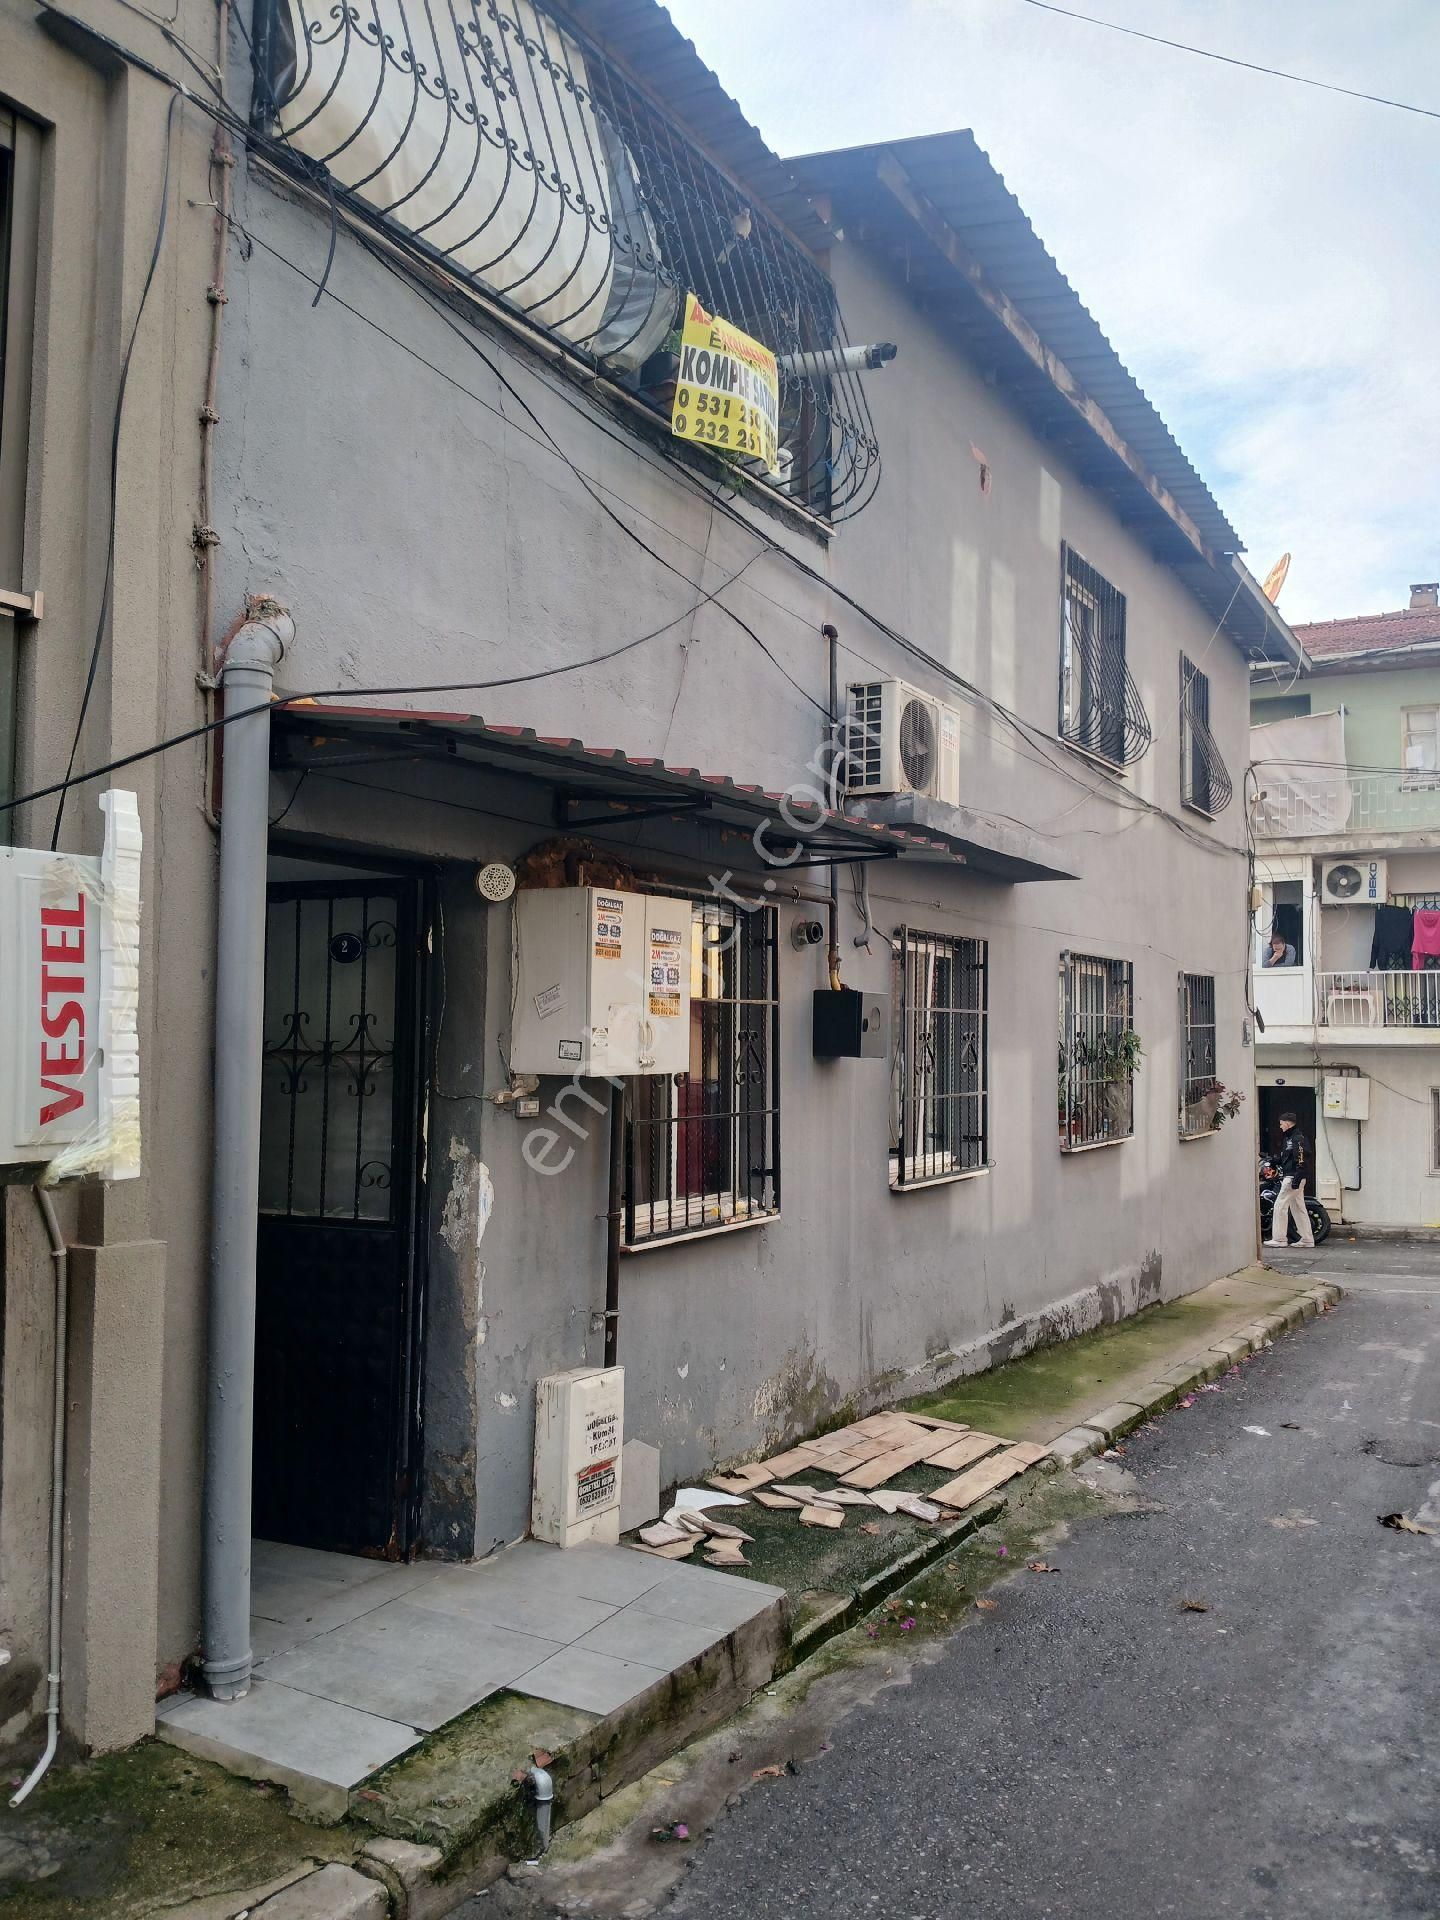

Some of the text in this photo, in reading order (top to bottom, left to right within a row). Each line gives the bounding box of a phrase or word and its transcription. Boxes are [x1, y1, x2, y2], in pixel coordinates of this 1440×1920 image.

[681, 345, 751, 401] KOMPLE
[678, 388, 690, 409] 0
[696, 393, 730, 419] 531
[675, 414, 687, 433] 0
[694, 418, 729, 444] 232
[1368, 862, 1377, 898] BEKO
[341, 940, 348, 953] 2
[651, 931, 681, 944] DOĞALGAZ
[40, 892, 85, 1126] VESTEL
